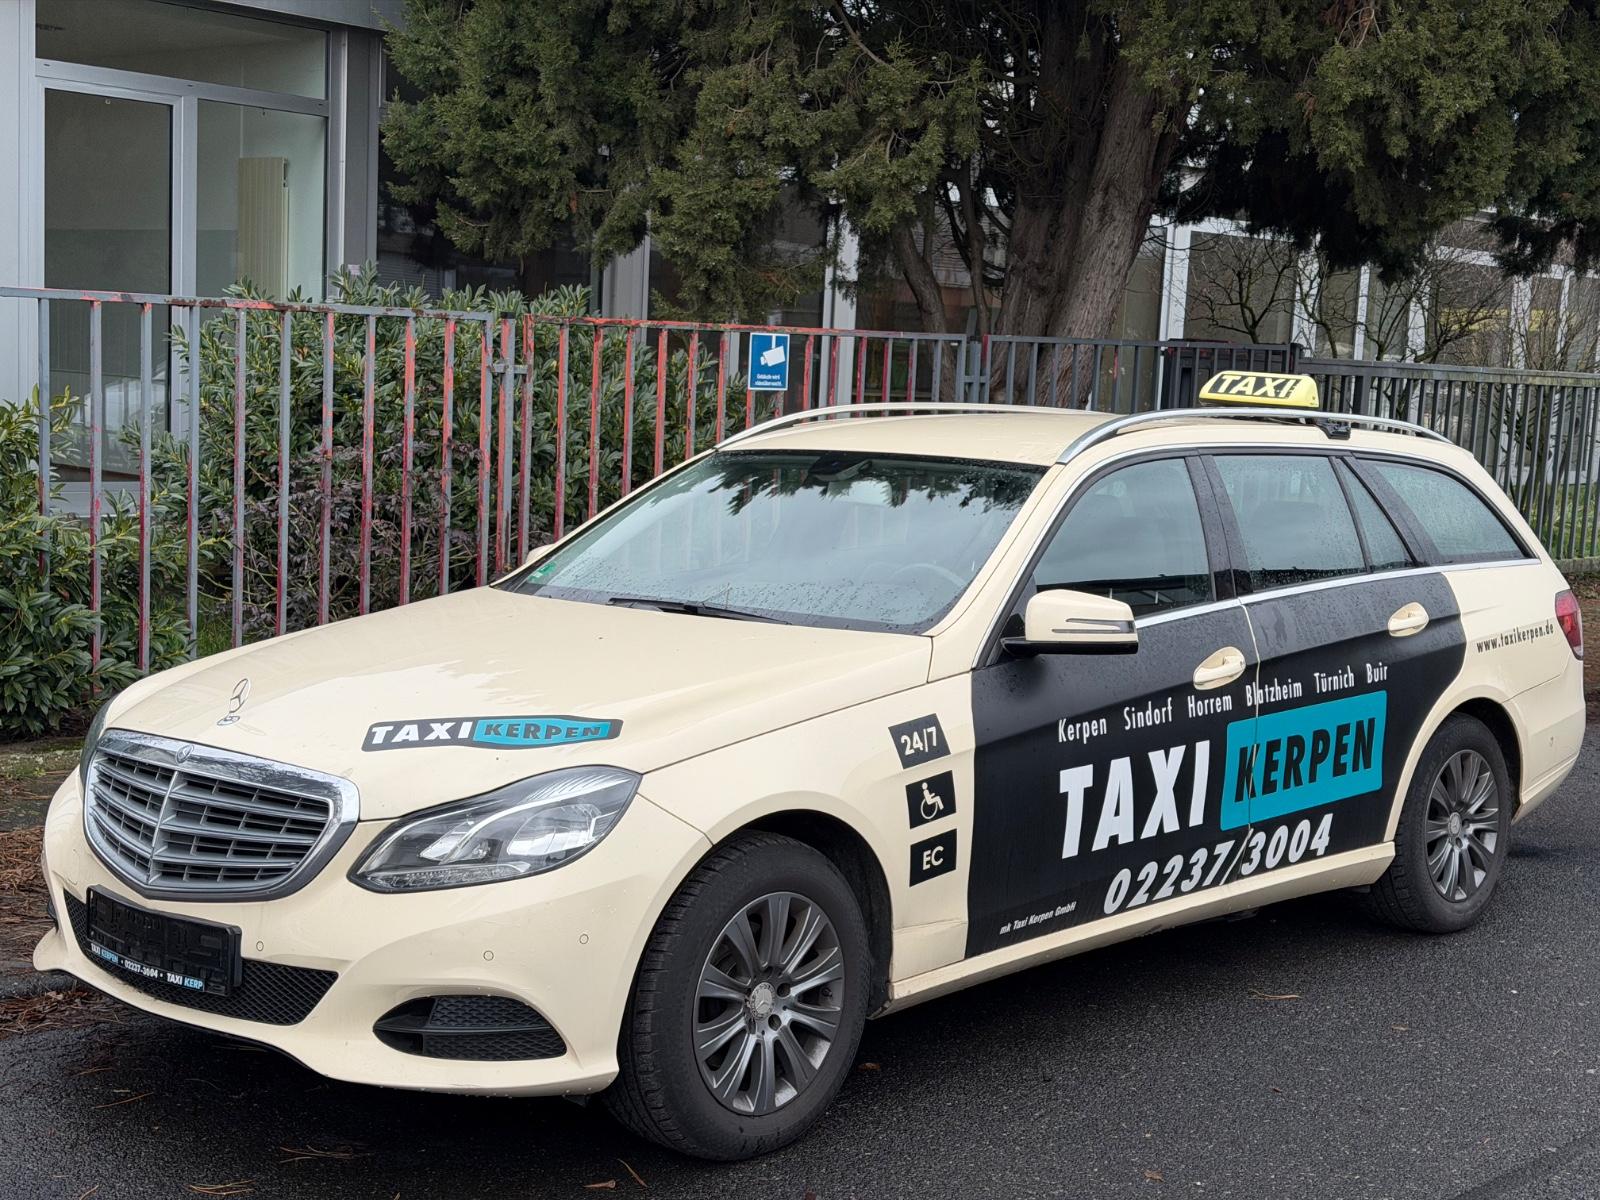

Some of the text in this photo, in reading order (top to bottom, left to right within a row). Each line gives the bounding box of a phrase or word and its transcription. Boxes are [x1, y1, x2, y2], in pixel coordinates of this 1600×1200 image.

[1217, 374, 1297, 398] TAXI
[1476, 619, 1554, 653] www.taxikerpen.de
[1058, 661, 1388, 745] Kerpen Sindorf Horrem Blatzheim Türnich Buir
[371, 721, 601, 745] TAXI KERPEN
[900, 726, 937, 756] 24/7
[1059, 717, 1376, 860] TAXI KERPEN
[922, 845, 944, 871] EC
[1103, 812, 1334, 915] 02237/3004
[1013, 917, 1029, 930] Taxi
[1054, 901, 1077, 917] GmbH
[166, 972, 183, 985] TAXI
